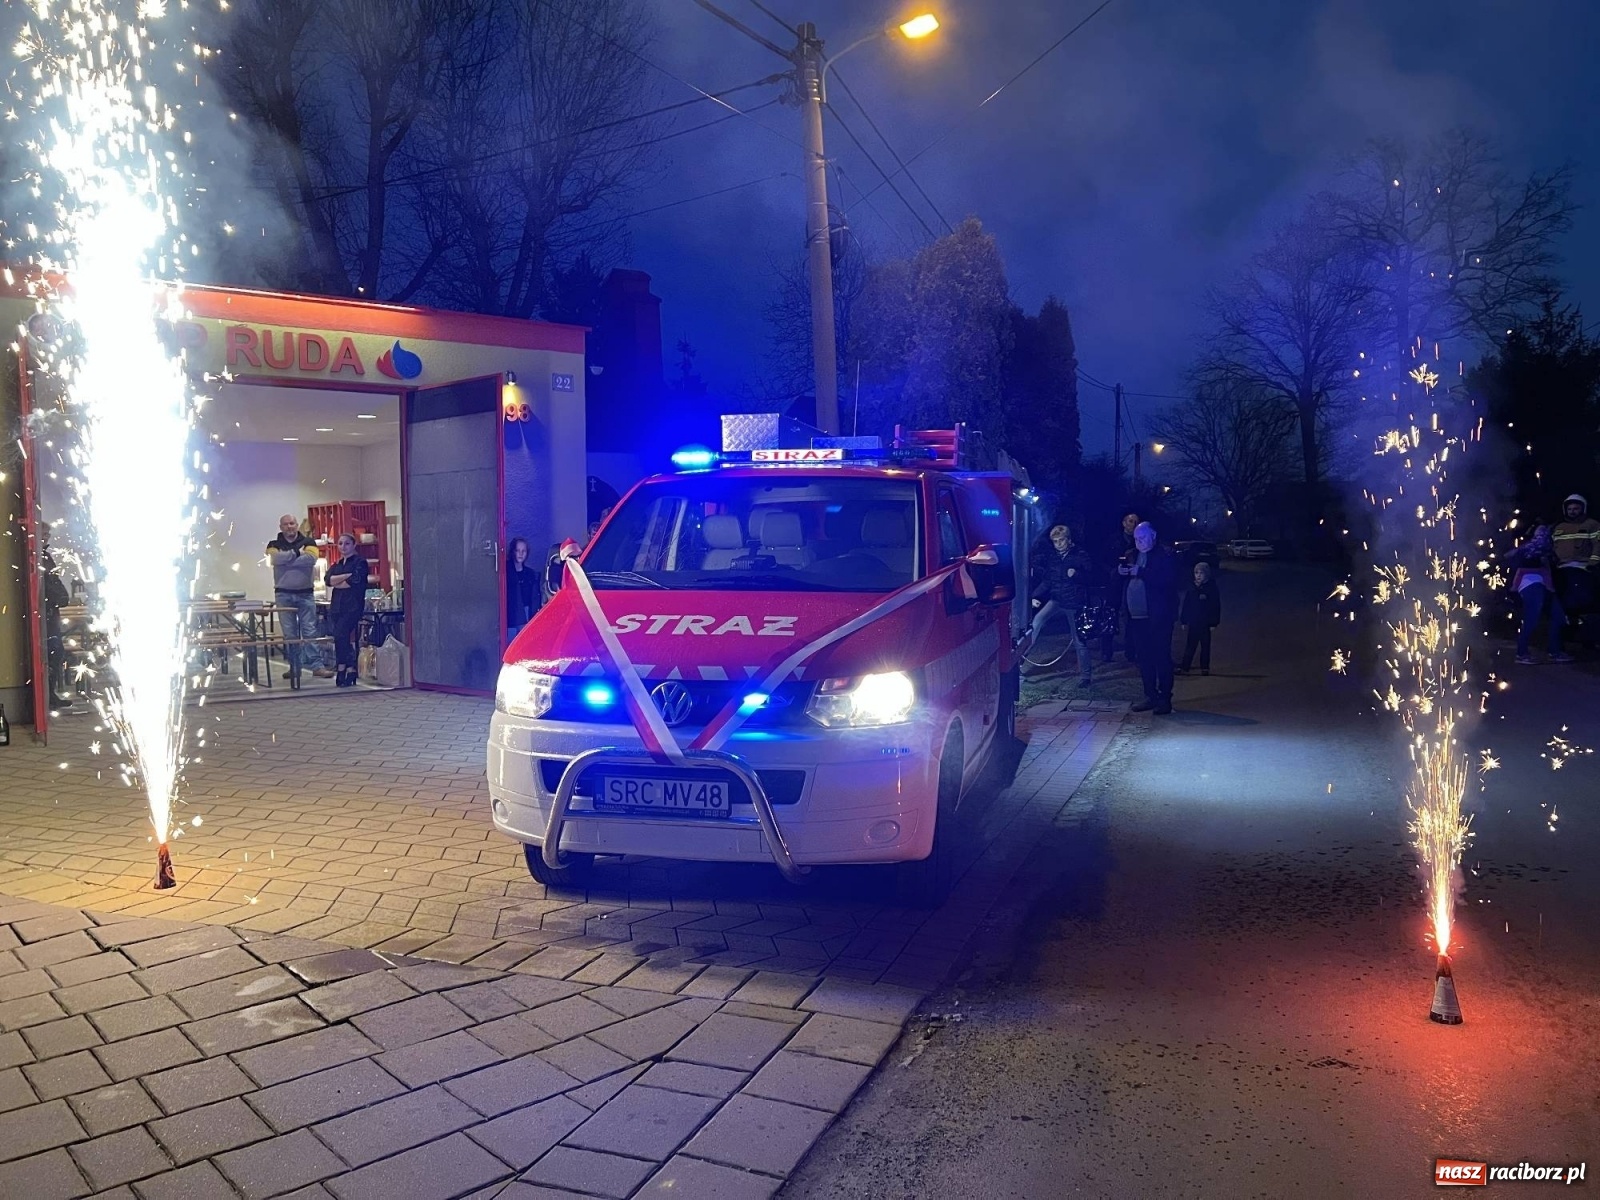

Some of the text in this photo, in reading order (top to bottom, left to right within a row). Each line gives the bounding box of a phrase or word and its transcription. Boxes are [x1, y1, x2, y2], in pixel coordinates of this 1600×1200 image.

[225, 326, 365, 375] RUDA
[556, 376, 571, 389] 22
[505, 403, 530, 422] 98
[609, 779, 722, 808] SRC MV48
